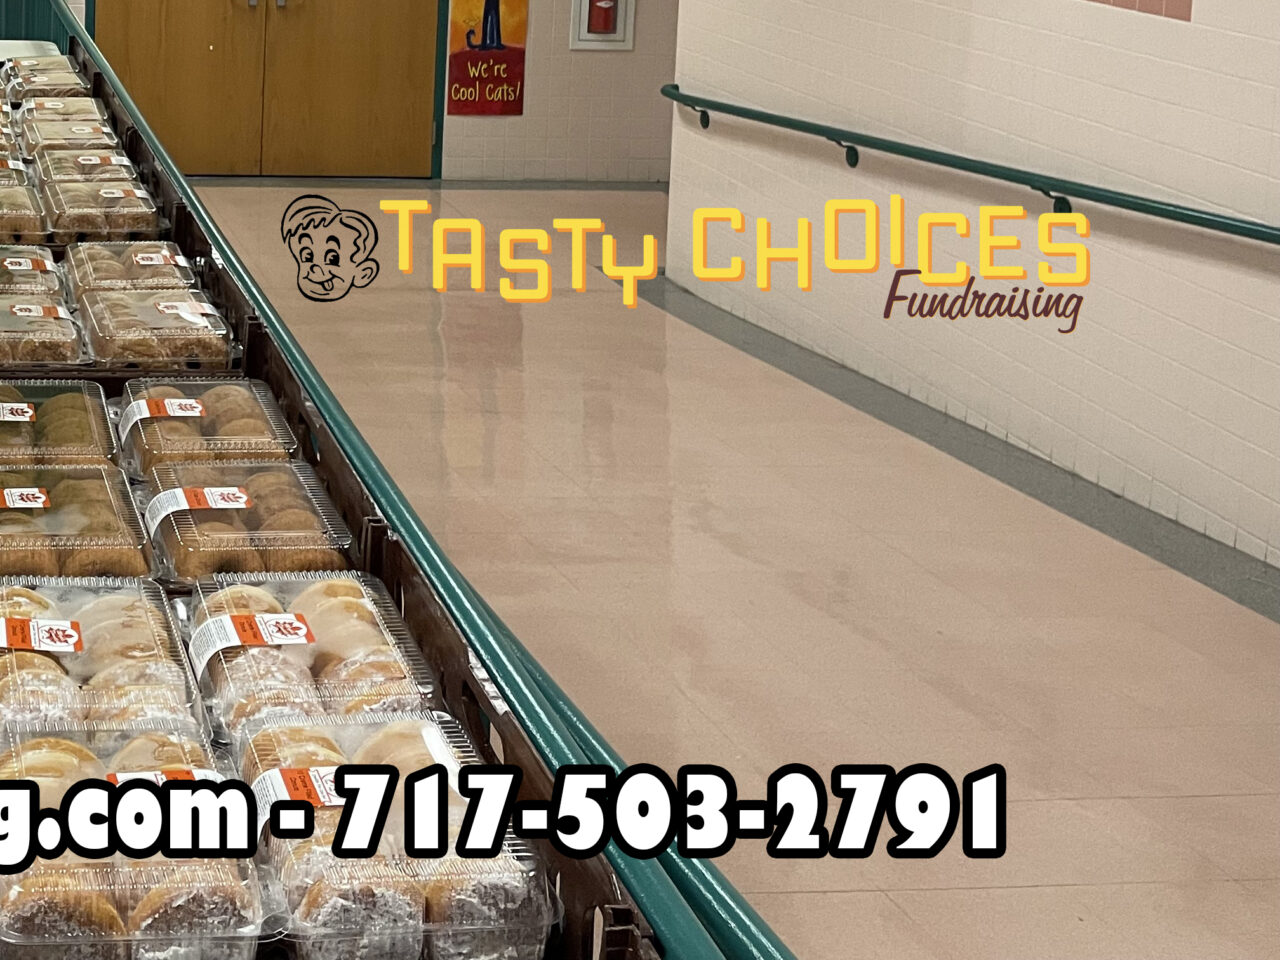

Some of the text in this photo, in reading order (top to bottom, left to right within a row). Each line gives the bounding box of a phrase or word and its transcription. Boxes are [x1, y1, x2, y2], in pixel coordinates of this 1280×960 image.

[467, 59, 508, 78] We're
[451, 80, 520, 102] Cool Cats!
